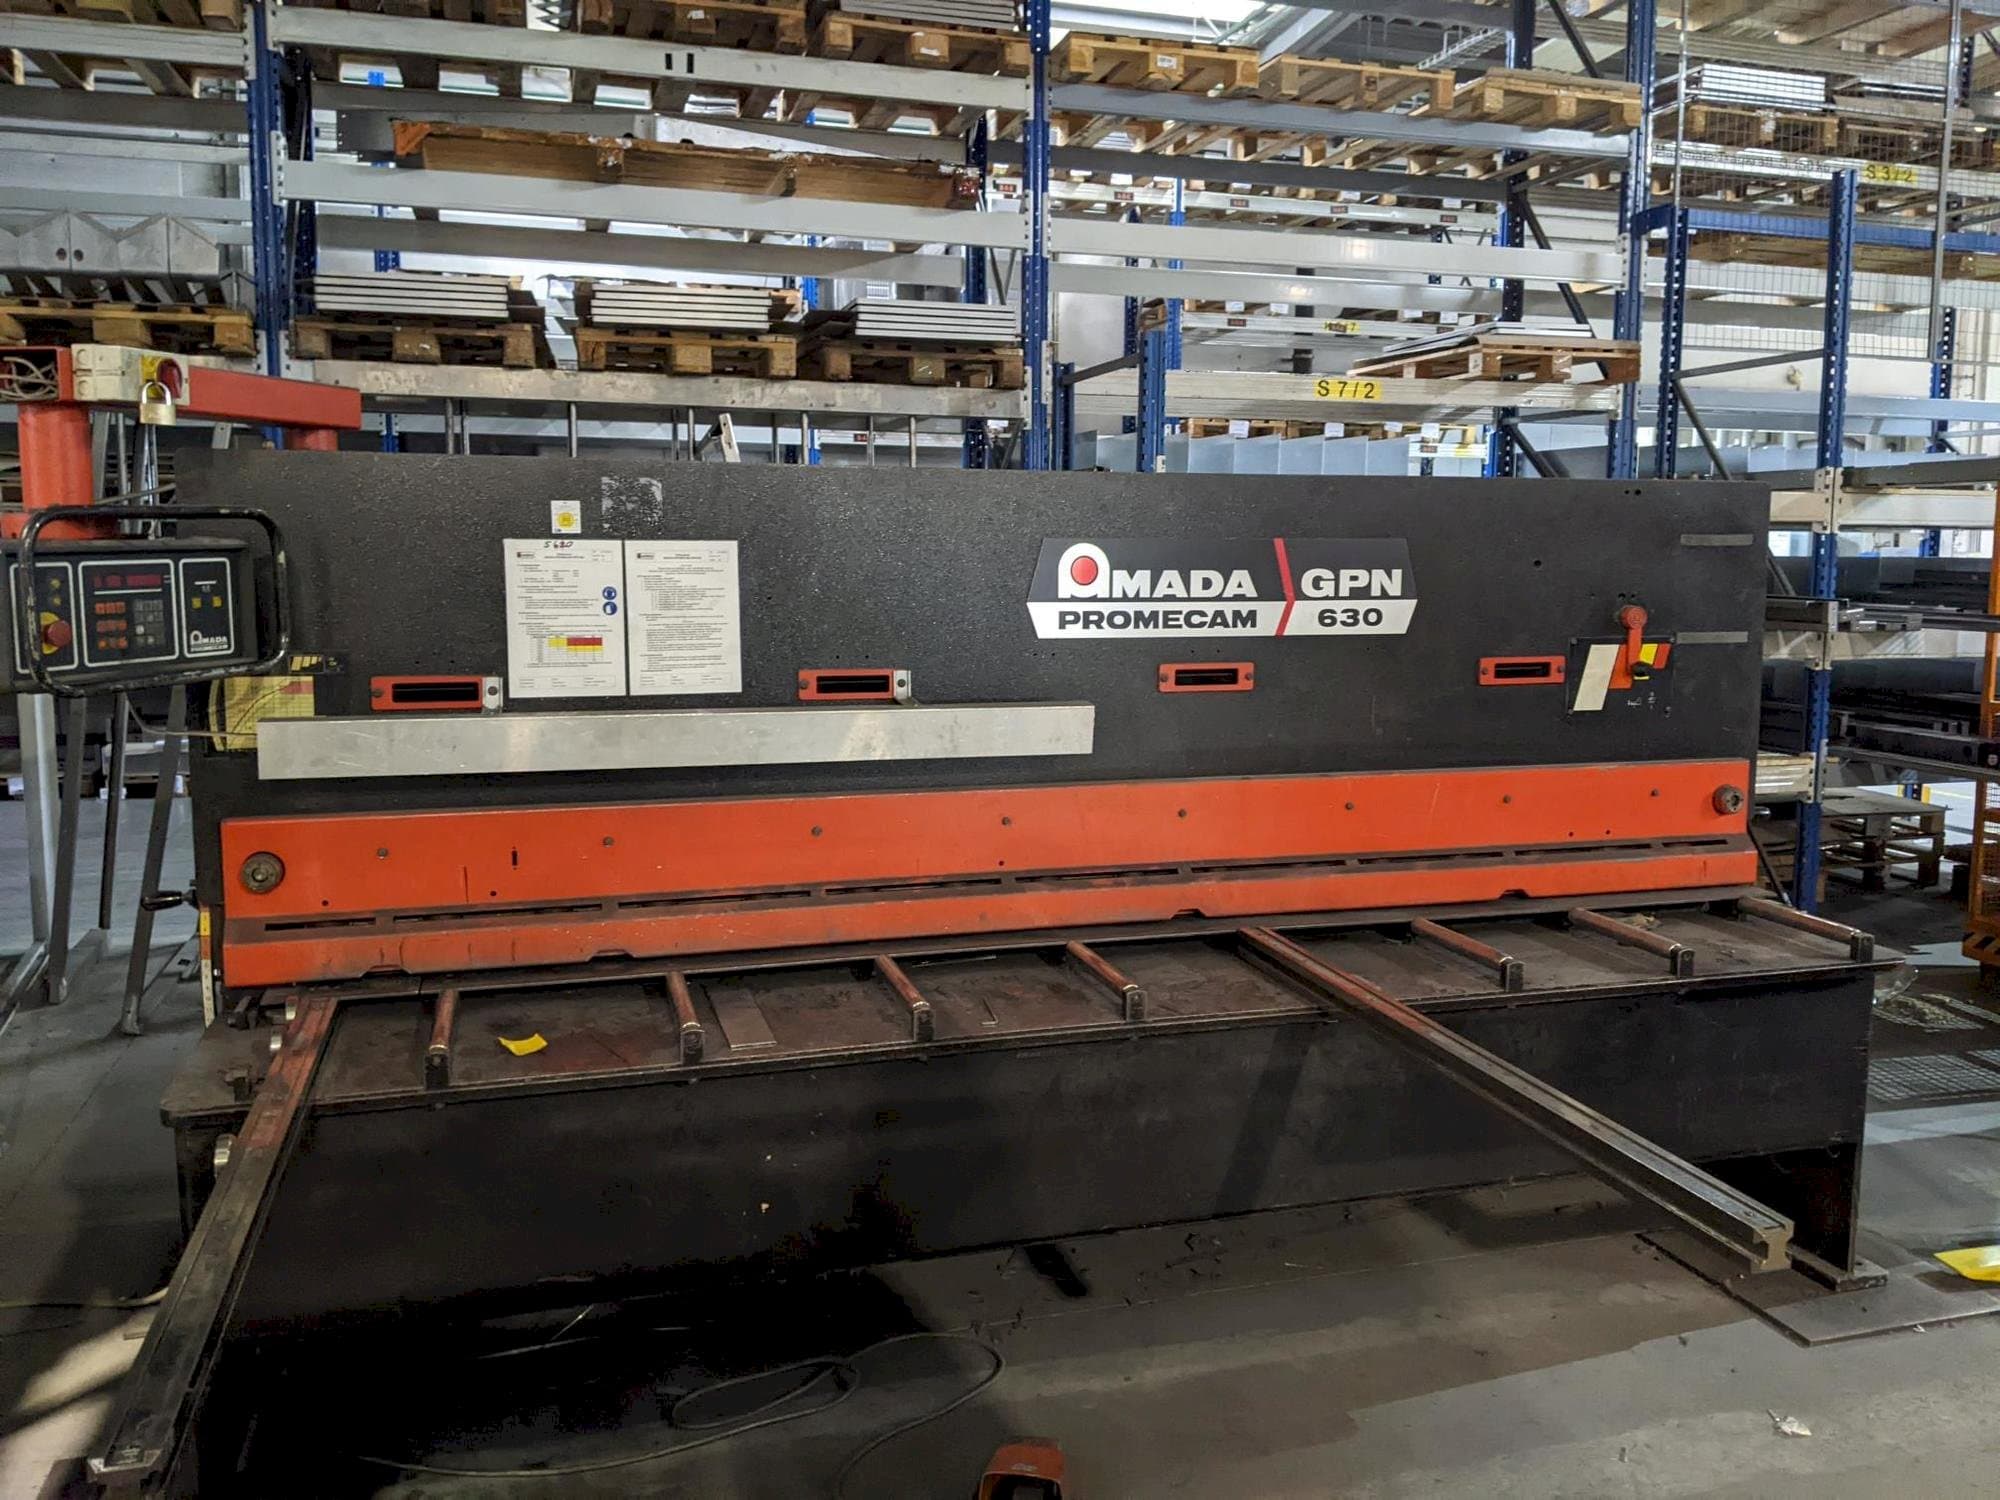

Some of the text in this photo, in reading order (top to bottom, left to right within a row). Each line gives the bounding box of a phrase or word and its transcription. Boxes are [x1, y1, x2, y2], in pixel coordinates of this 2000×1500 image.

[1057, 542, 1259, 599] AMADA
[1301, 567, 1403, 598] GPN
[1058, 609, 1258, 630] PROMECAM
[1317, 607, 1383, 628] 630
